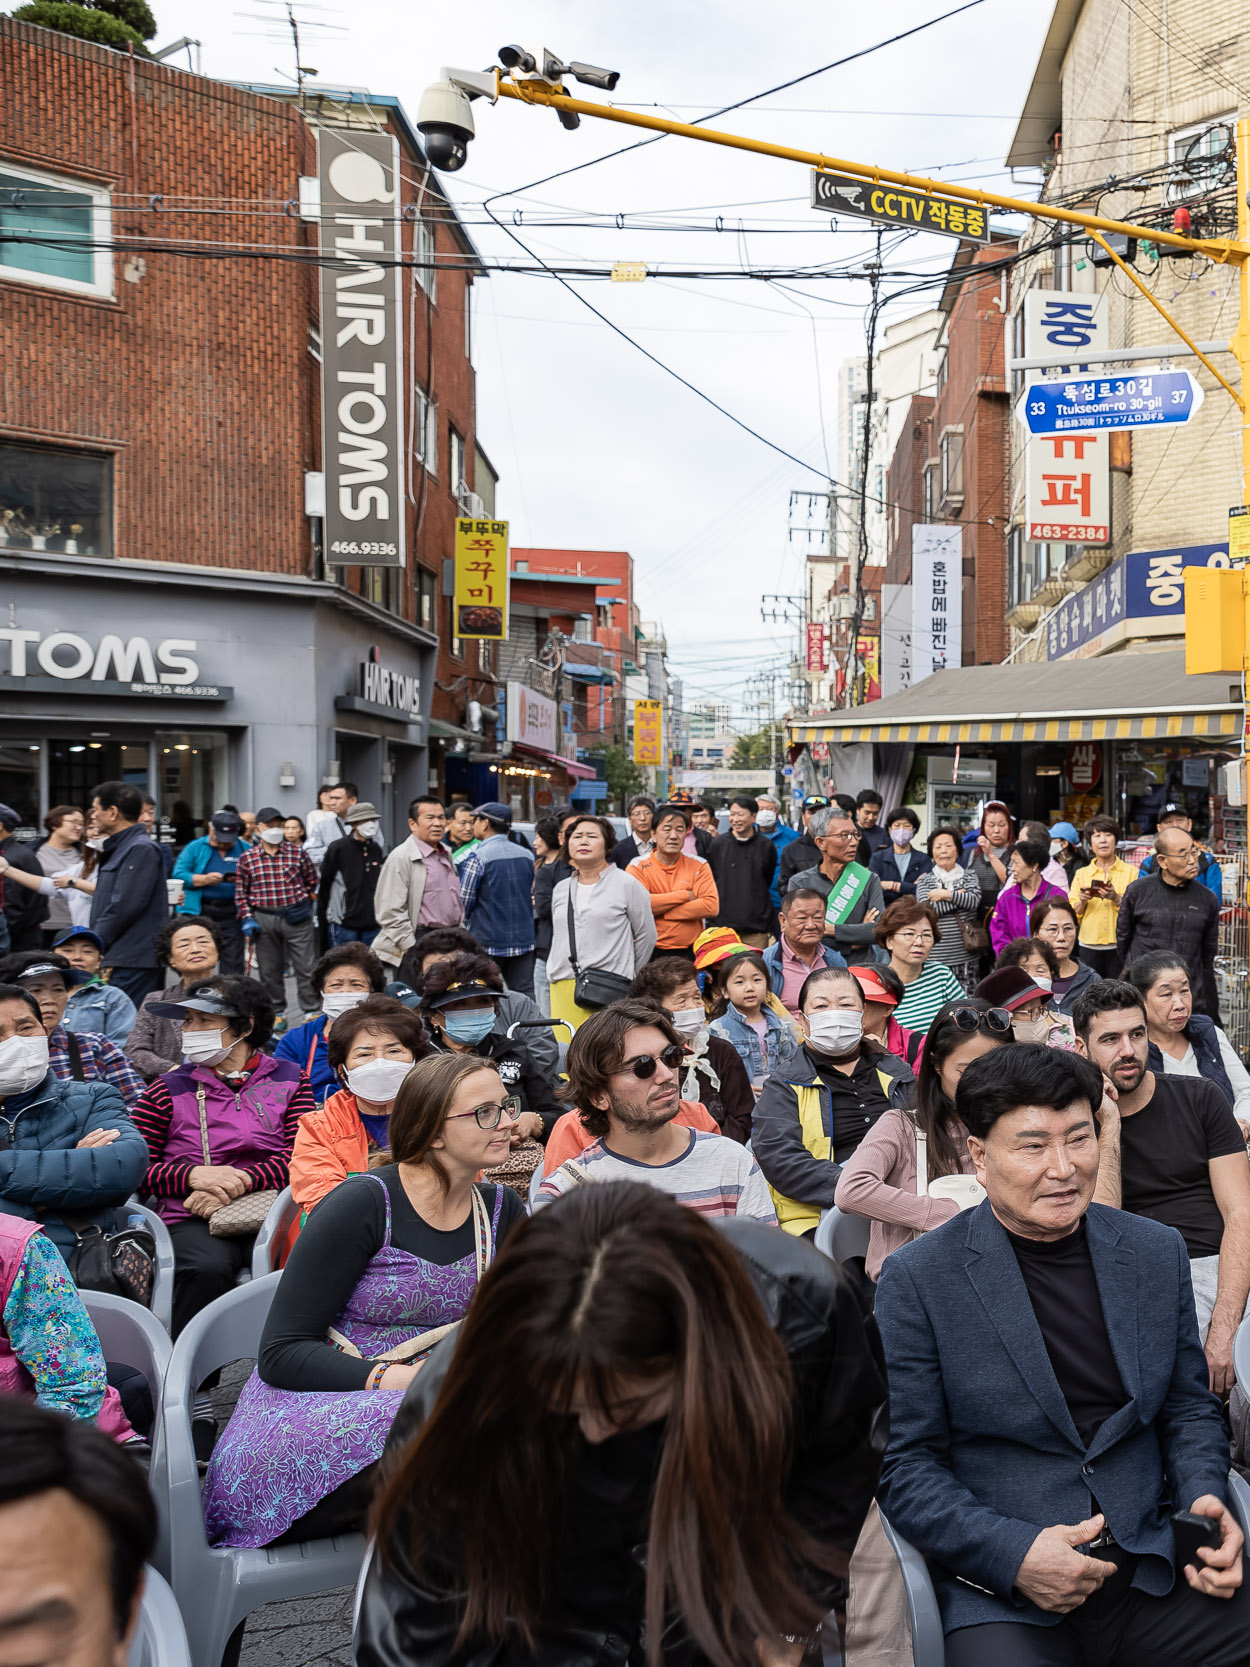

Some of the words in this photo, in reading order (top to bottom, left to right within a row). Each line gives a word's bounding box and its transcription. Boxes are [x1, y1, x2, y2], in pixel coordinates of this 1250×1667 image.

[870, 190, 925, 222] CCTV
[929, 201, 984, 237] 작동중
[334, 213, 387, 347] HAIR
[1030, 401, 1046, 415] 33
[1056, 400, 1127, 416] Ttukseom-ro
[1129, 396, 1163, 411] 30-gil
[1171, 389, 1188, 404] 37
[1063, 377, 1154, 402] 뚝섬로30길
[336, 361, 391, 522] TOMS
[330, 540, 397, 557] 466.9336
[458, 520, 507, 538] 부뚜막
[1033, 525, 1106, 540] 463-2384
[465, 538, 497, 605] 쭈꾸미
[931, 561, 949, 613] 혼밥에
[0, 627, 200, 686] TOMS
[931, 616, 949, 651] 빠진
[363, 661, 392, 707] HAIR
[391, 671, 420, 714] TOMS
